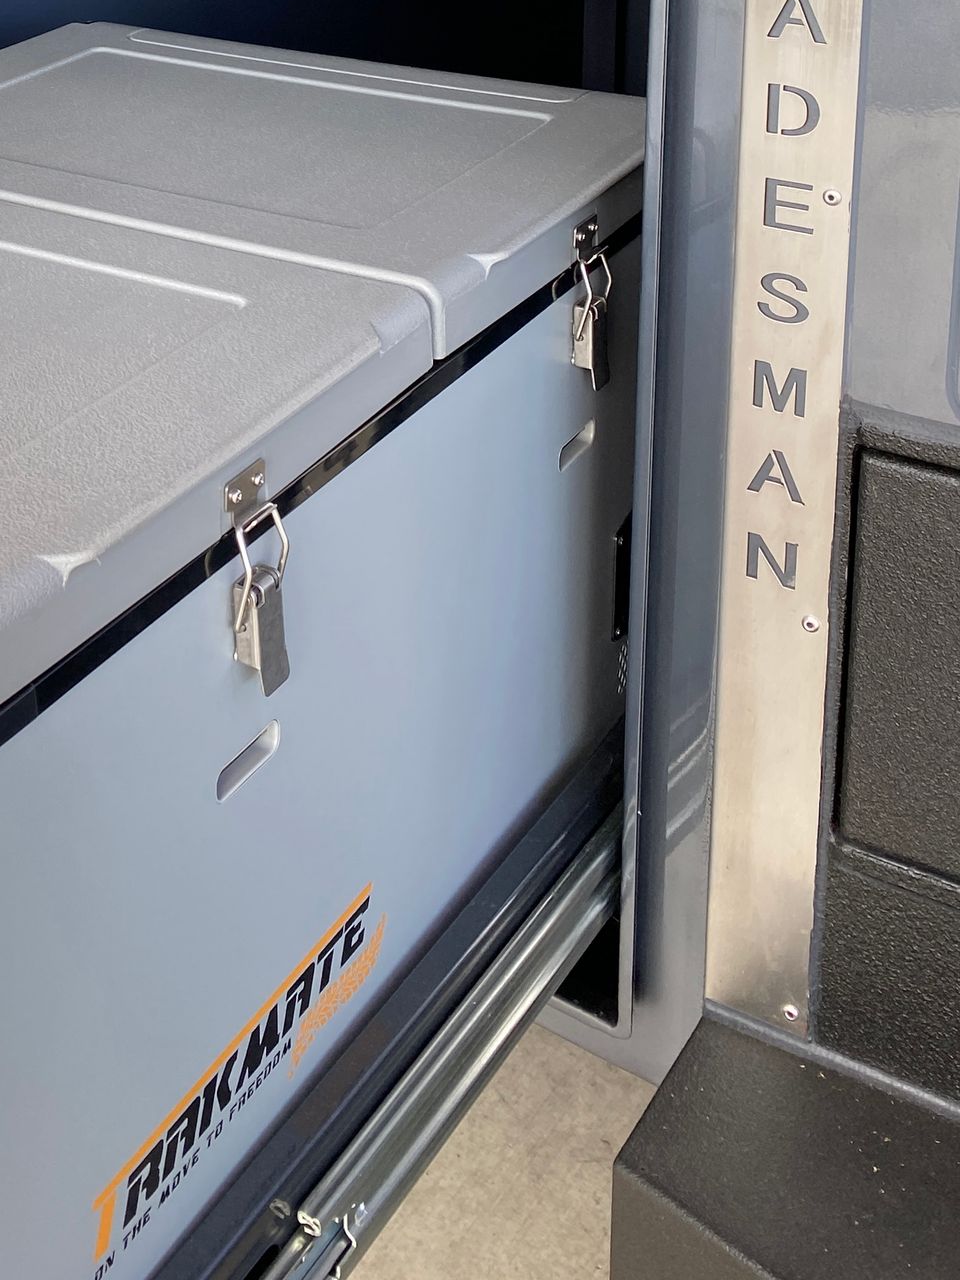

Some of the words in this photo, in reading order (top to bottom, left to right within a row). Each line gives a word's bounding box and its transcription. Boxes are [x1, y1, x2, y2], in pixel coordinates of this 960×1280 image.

[92, 881, 373, 1263] TRAKMATE
[94, 1250, 116, 1280] ON
[122, 1206, 151, 1250] THE
[158, 1152, 200, 1208] MOVE
[206, 1119, 224, 1148] TO
[229, 1037, 292, 1122] FREEDOM
